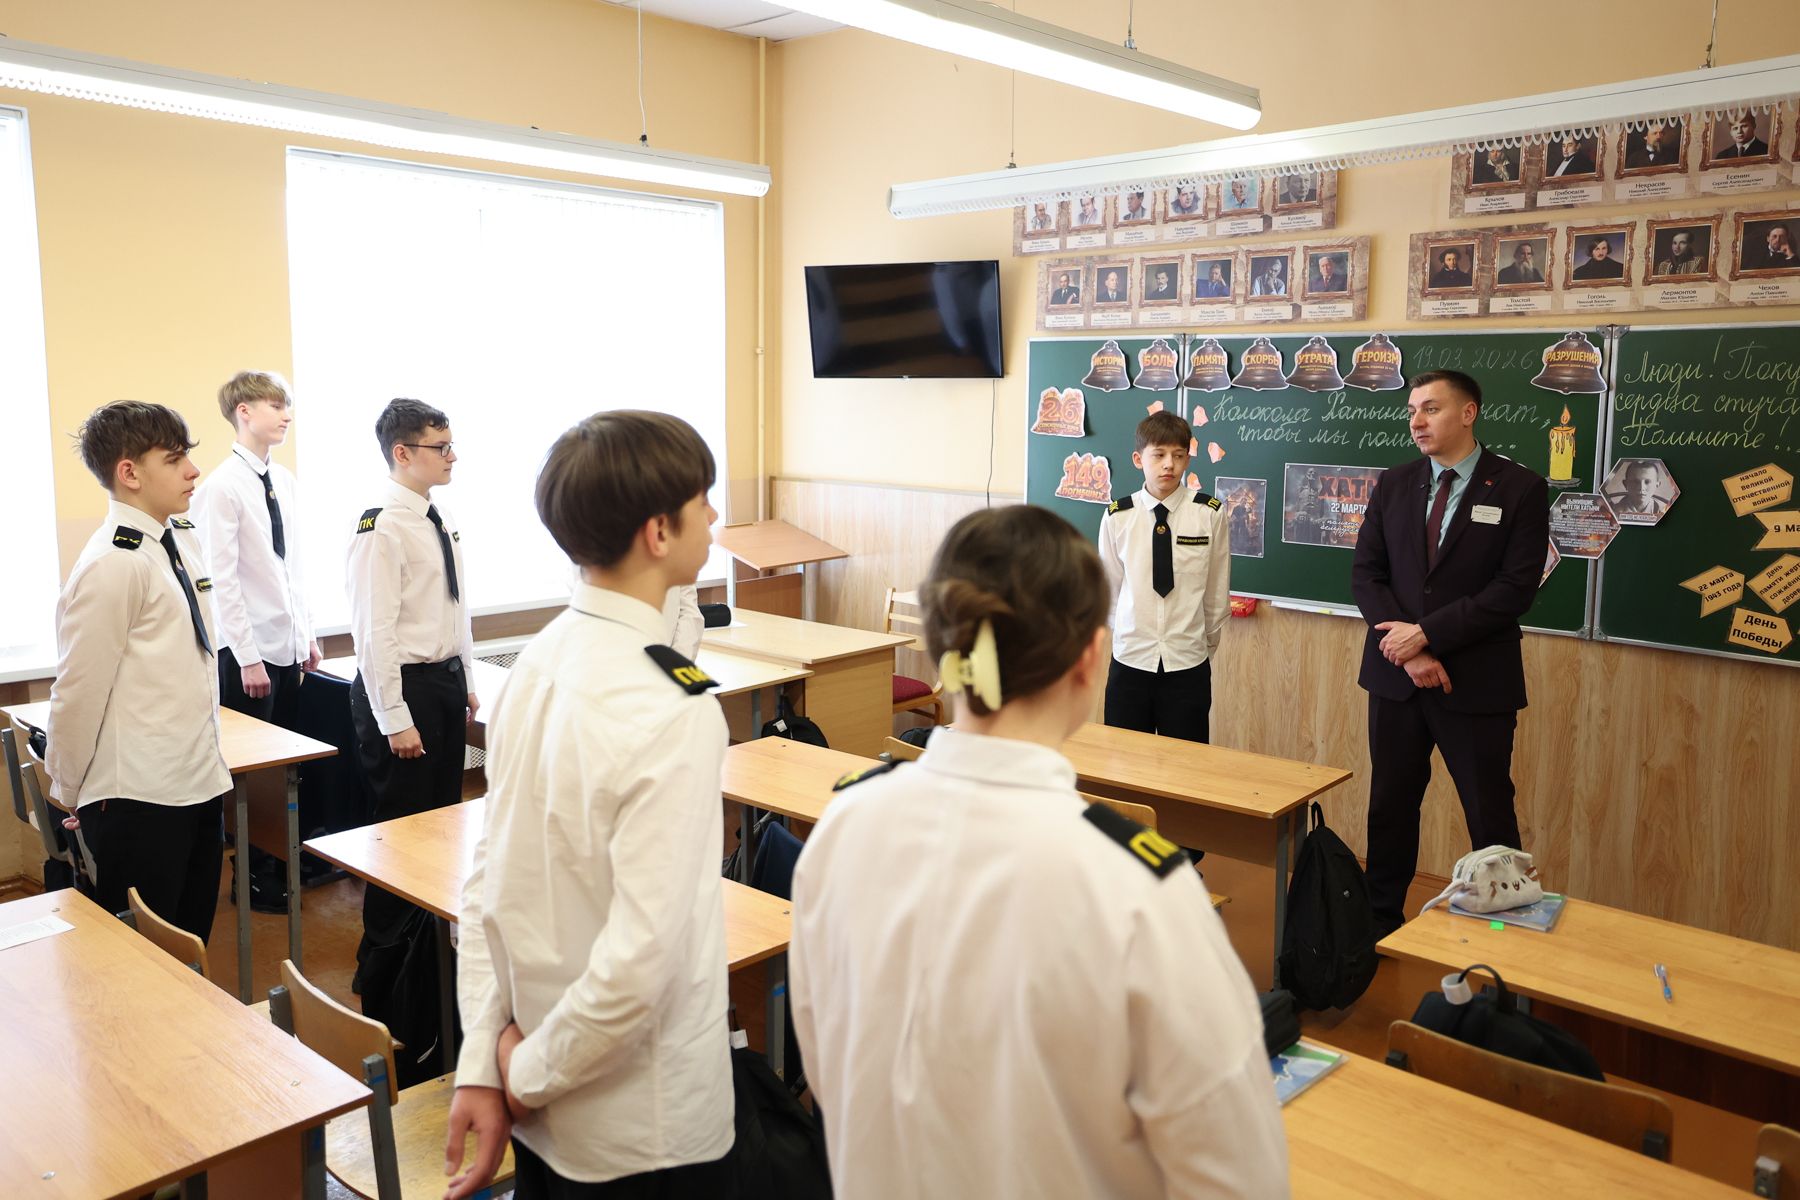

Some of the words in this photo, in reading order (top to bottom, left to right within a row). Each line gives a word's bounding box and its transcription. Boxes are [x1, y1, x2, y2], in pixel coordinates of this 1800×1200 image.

[1726, 173, 1751, 181] Есенин
[1635, 182, 1666, 190] Некрасов
[1143, 354, 1176, 368] БОЛЬ
[1192, 354, 1227, 367] ПАМЯТЬ
[1246, 354, 1280, 366] СКОРБЬ
[1297, 352, 1334, 366] УТРАТА
[1356, 351, 1400, 365] ГЕРОИЗМ
[1547, 351, 1600, 364] РАЗРУШЕНИЯ
[1042, 396, 1081, 425] 26
[1213, 393, 1313, 423] Колокола
[1615, 393, 1705, 428] сердца
[1236, 420, 1302, 443] чтобы
[1308, 428, 1350, 444] мы
[1065, 458, 1108, 490] 149
[1330, 502, 1341, 512] 22
[1752, 495, 1778, 507] войны
[359, 517, 374, 530] ПК
[1774, 525, 1781, 533] 9
[1698, 582, 1709, 592] 22
[1709, 571, 1735, 587] марта
[1759, 575, 1784, 596] памяти
[1704, 590, 1722, 604] 1943
[1722, 581, 1743, 596] года
[1744, 615, 1778, 632] День
[1732, 628, 1784, 650] Победы
